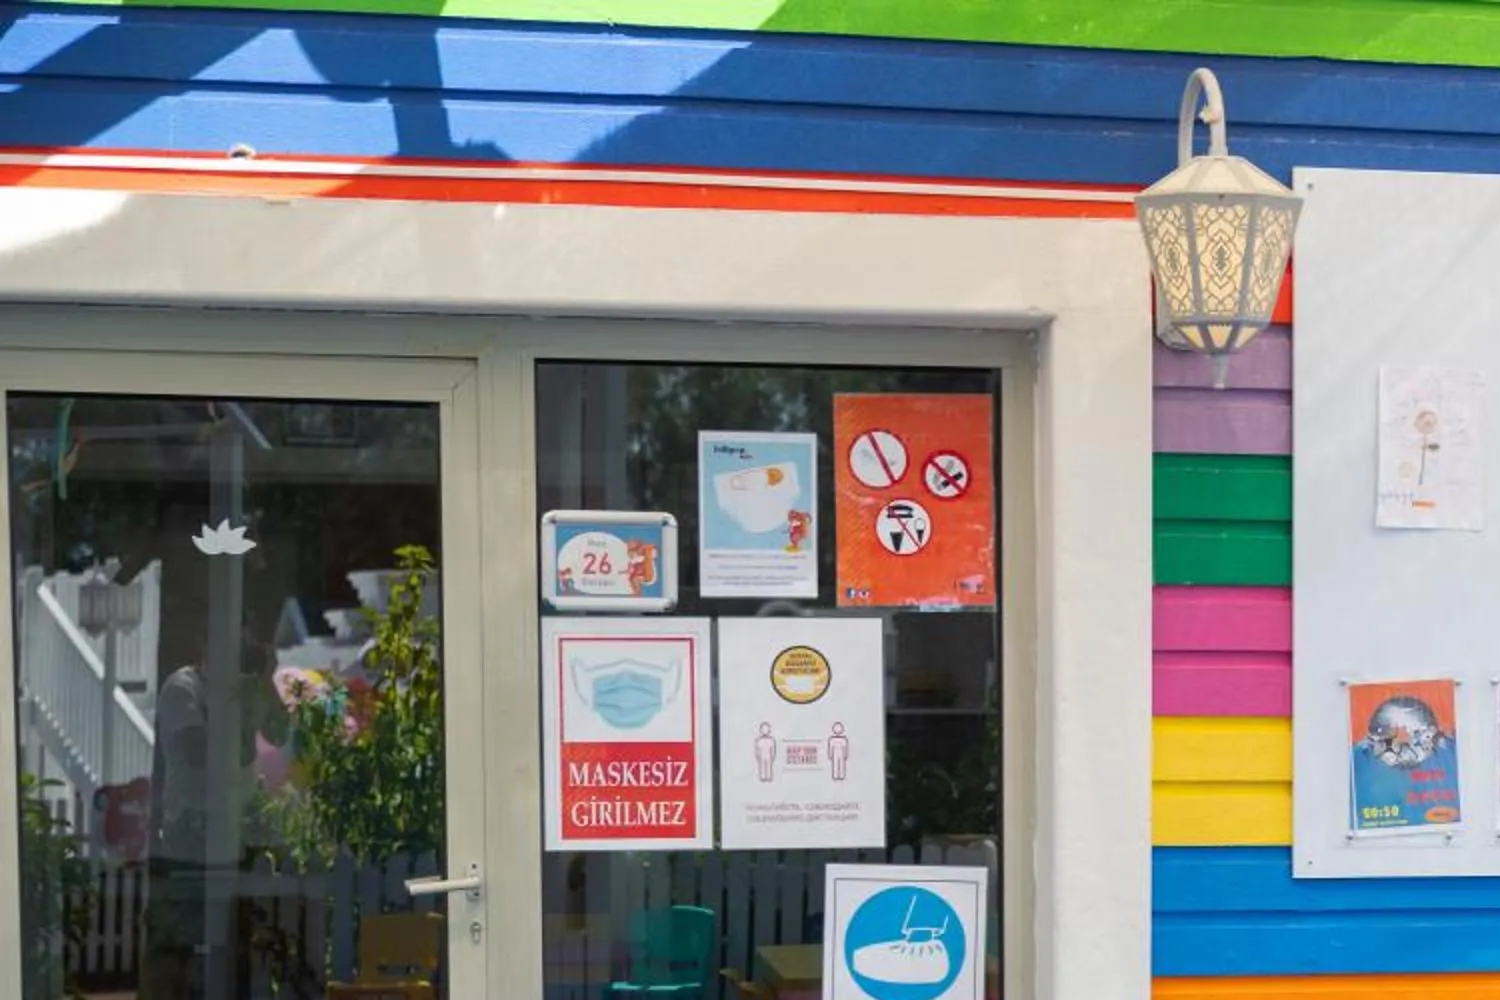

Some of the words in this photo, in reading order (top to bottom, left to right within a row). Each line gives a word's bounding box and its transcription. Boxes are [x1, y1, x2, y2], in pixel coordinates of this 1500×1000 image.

[582, 551, 613, 576] 26
[568, 754, 689, 788] MASKESİZ
[570, 794, 688, 828] GİRİLMEZ
